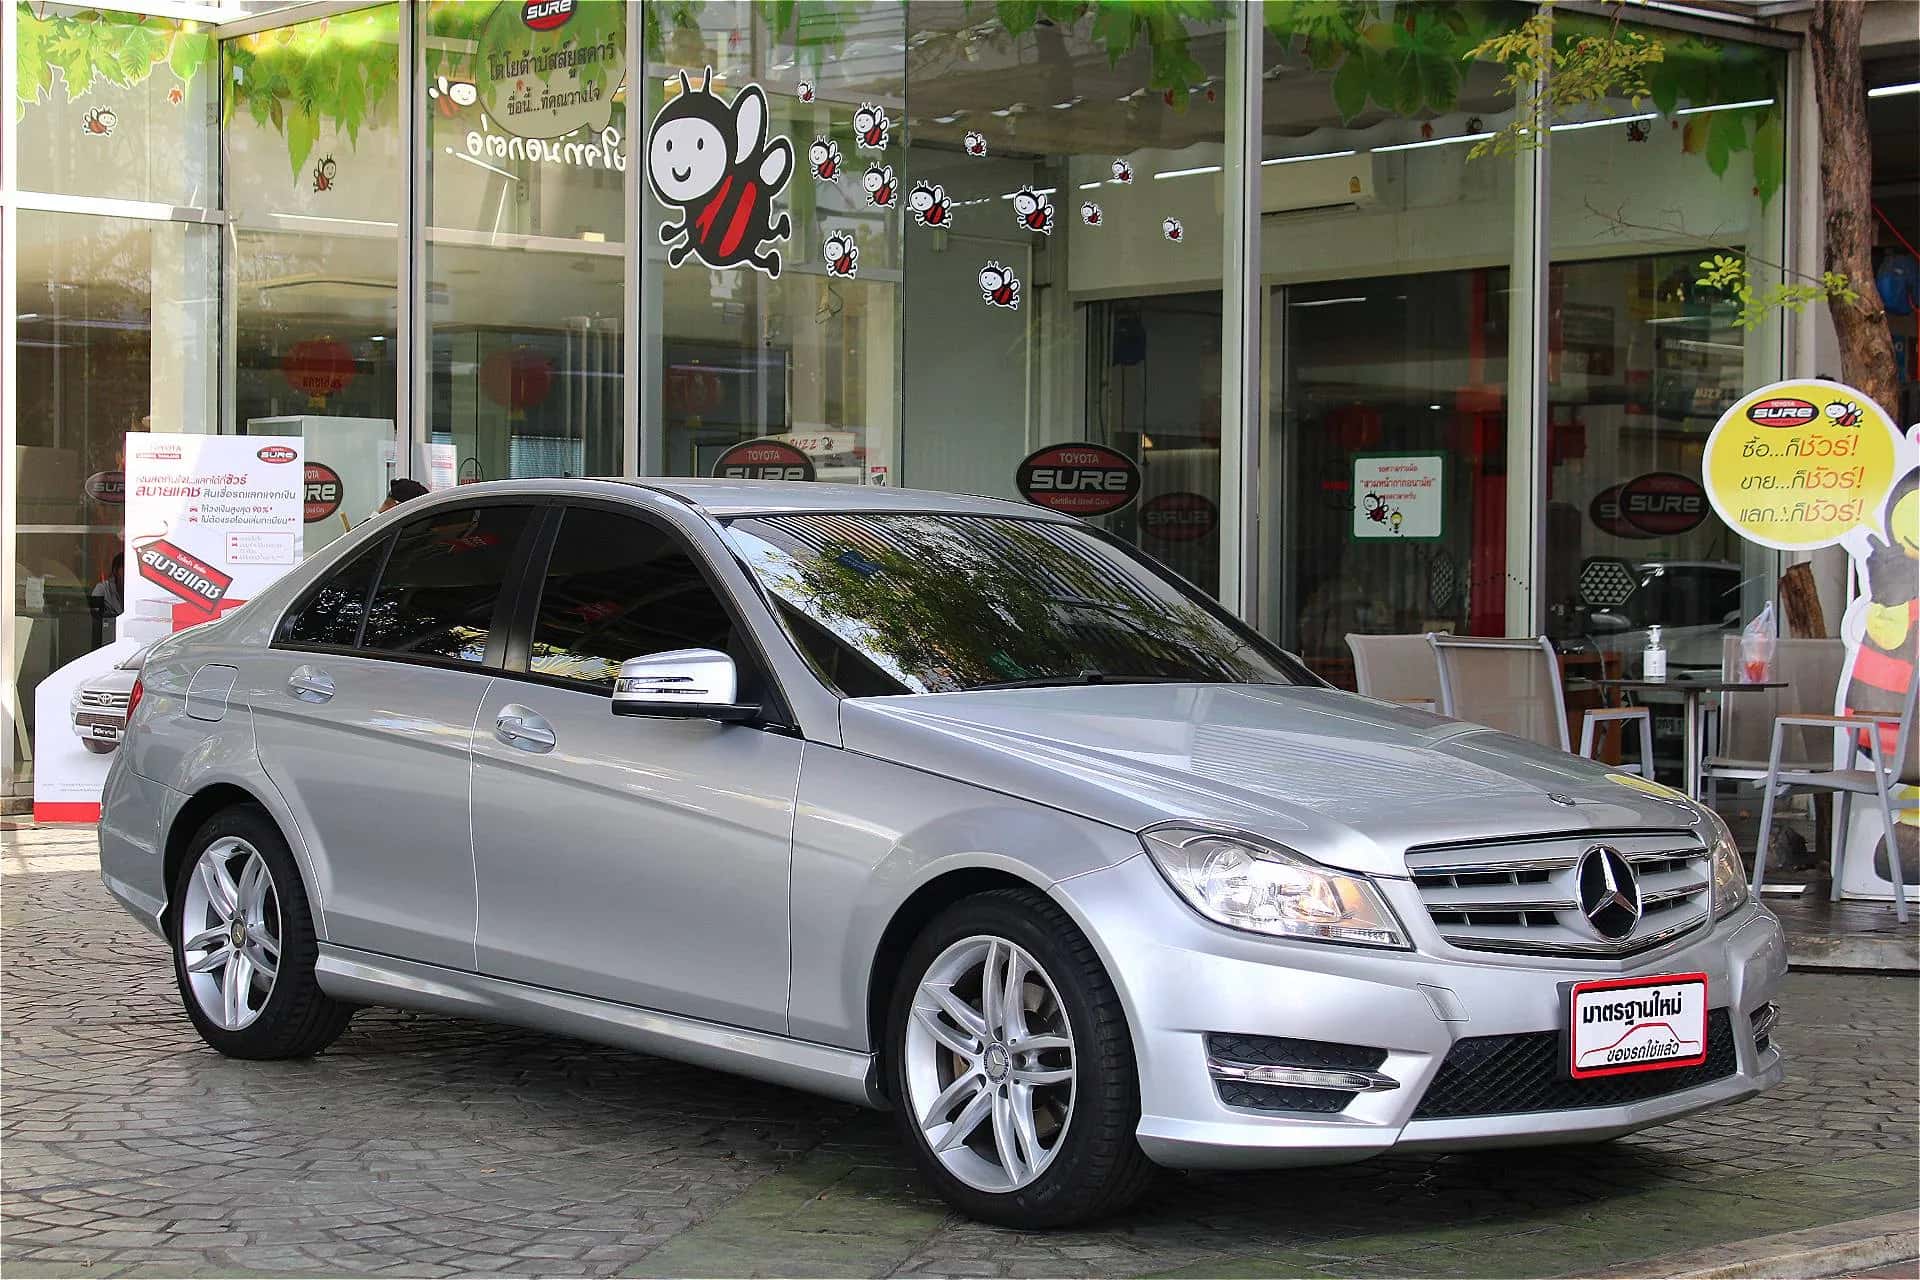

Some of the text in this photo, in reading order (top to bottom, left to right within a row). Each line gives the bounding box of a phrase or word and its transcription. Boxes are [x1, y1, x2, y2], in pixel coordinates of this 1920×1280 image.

[747, 450, 781, 460] TOYOTA
[1059, 453, 1100, 464] TOYOTA
[1740, 466, 1865, 490] ขาย...ก็ชัวร์!
[1739, 499, 1864, 523] แลก...ก็ชัวร์!
[141, 549, 223, 600] สบายแคช
[1583, 990, 1682, 1026] มาตรฐานใหม่
[1607, 1038, 1680, 1062] ของรถใช้แล้ว
